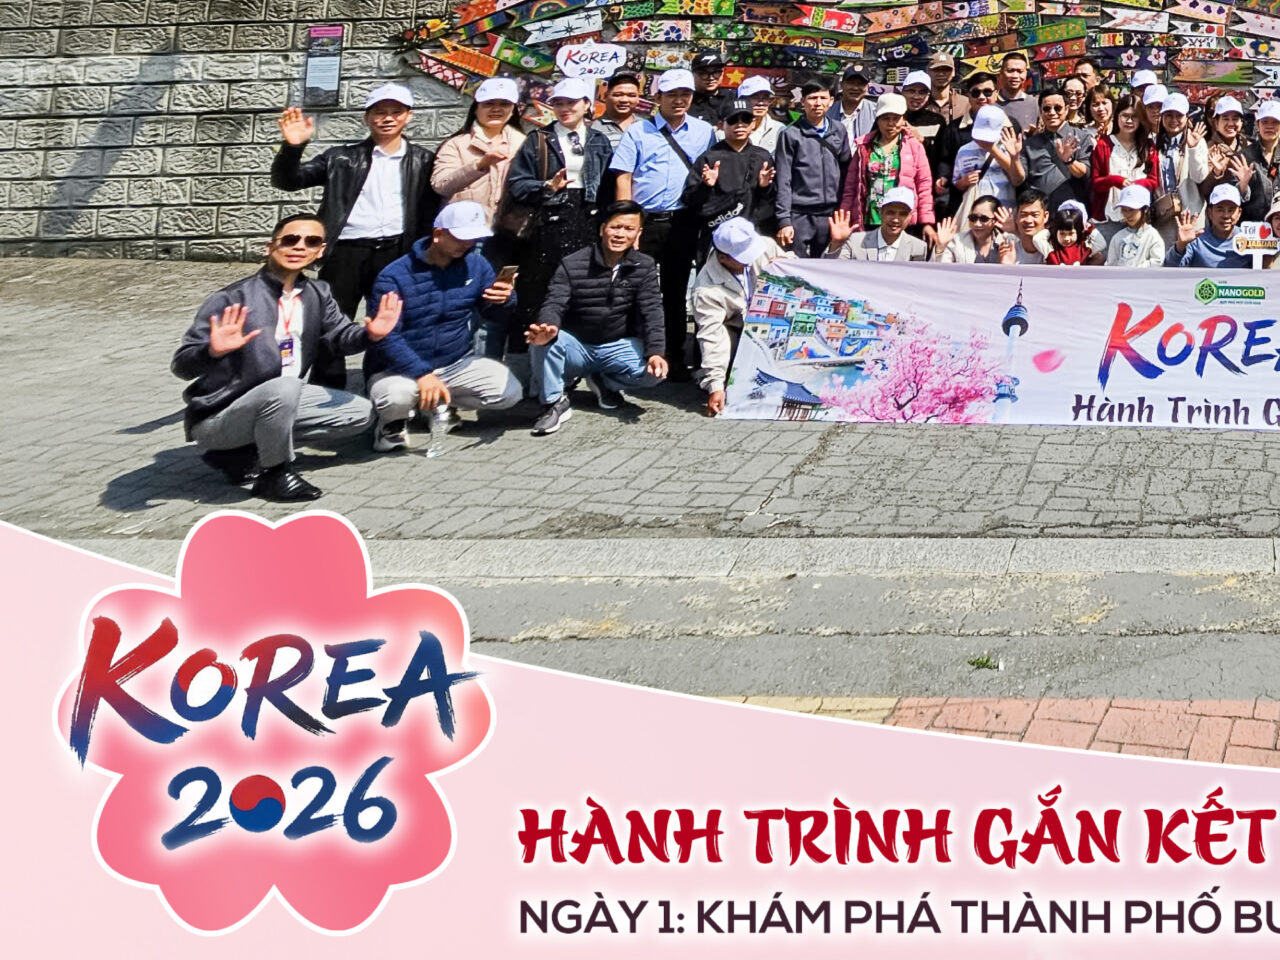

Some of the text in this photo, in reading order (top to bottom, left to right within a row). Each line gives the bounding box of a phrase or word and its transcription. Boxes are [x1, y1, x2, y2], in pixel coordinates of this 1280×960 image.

[563, 49, 620, 66] KOREA
[1072, 394, 1154, 423] Hành
[1167, 396, 1250, 425] Trình
